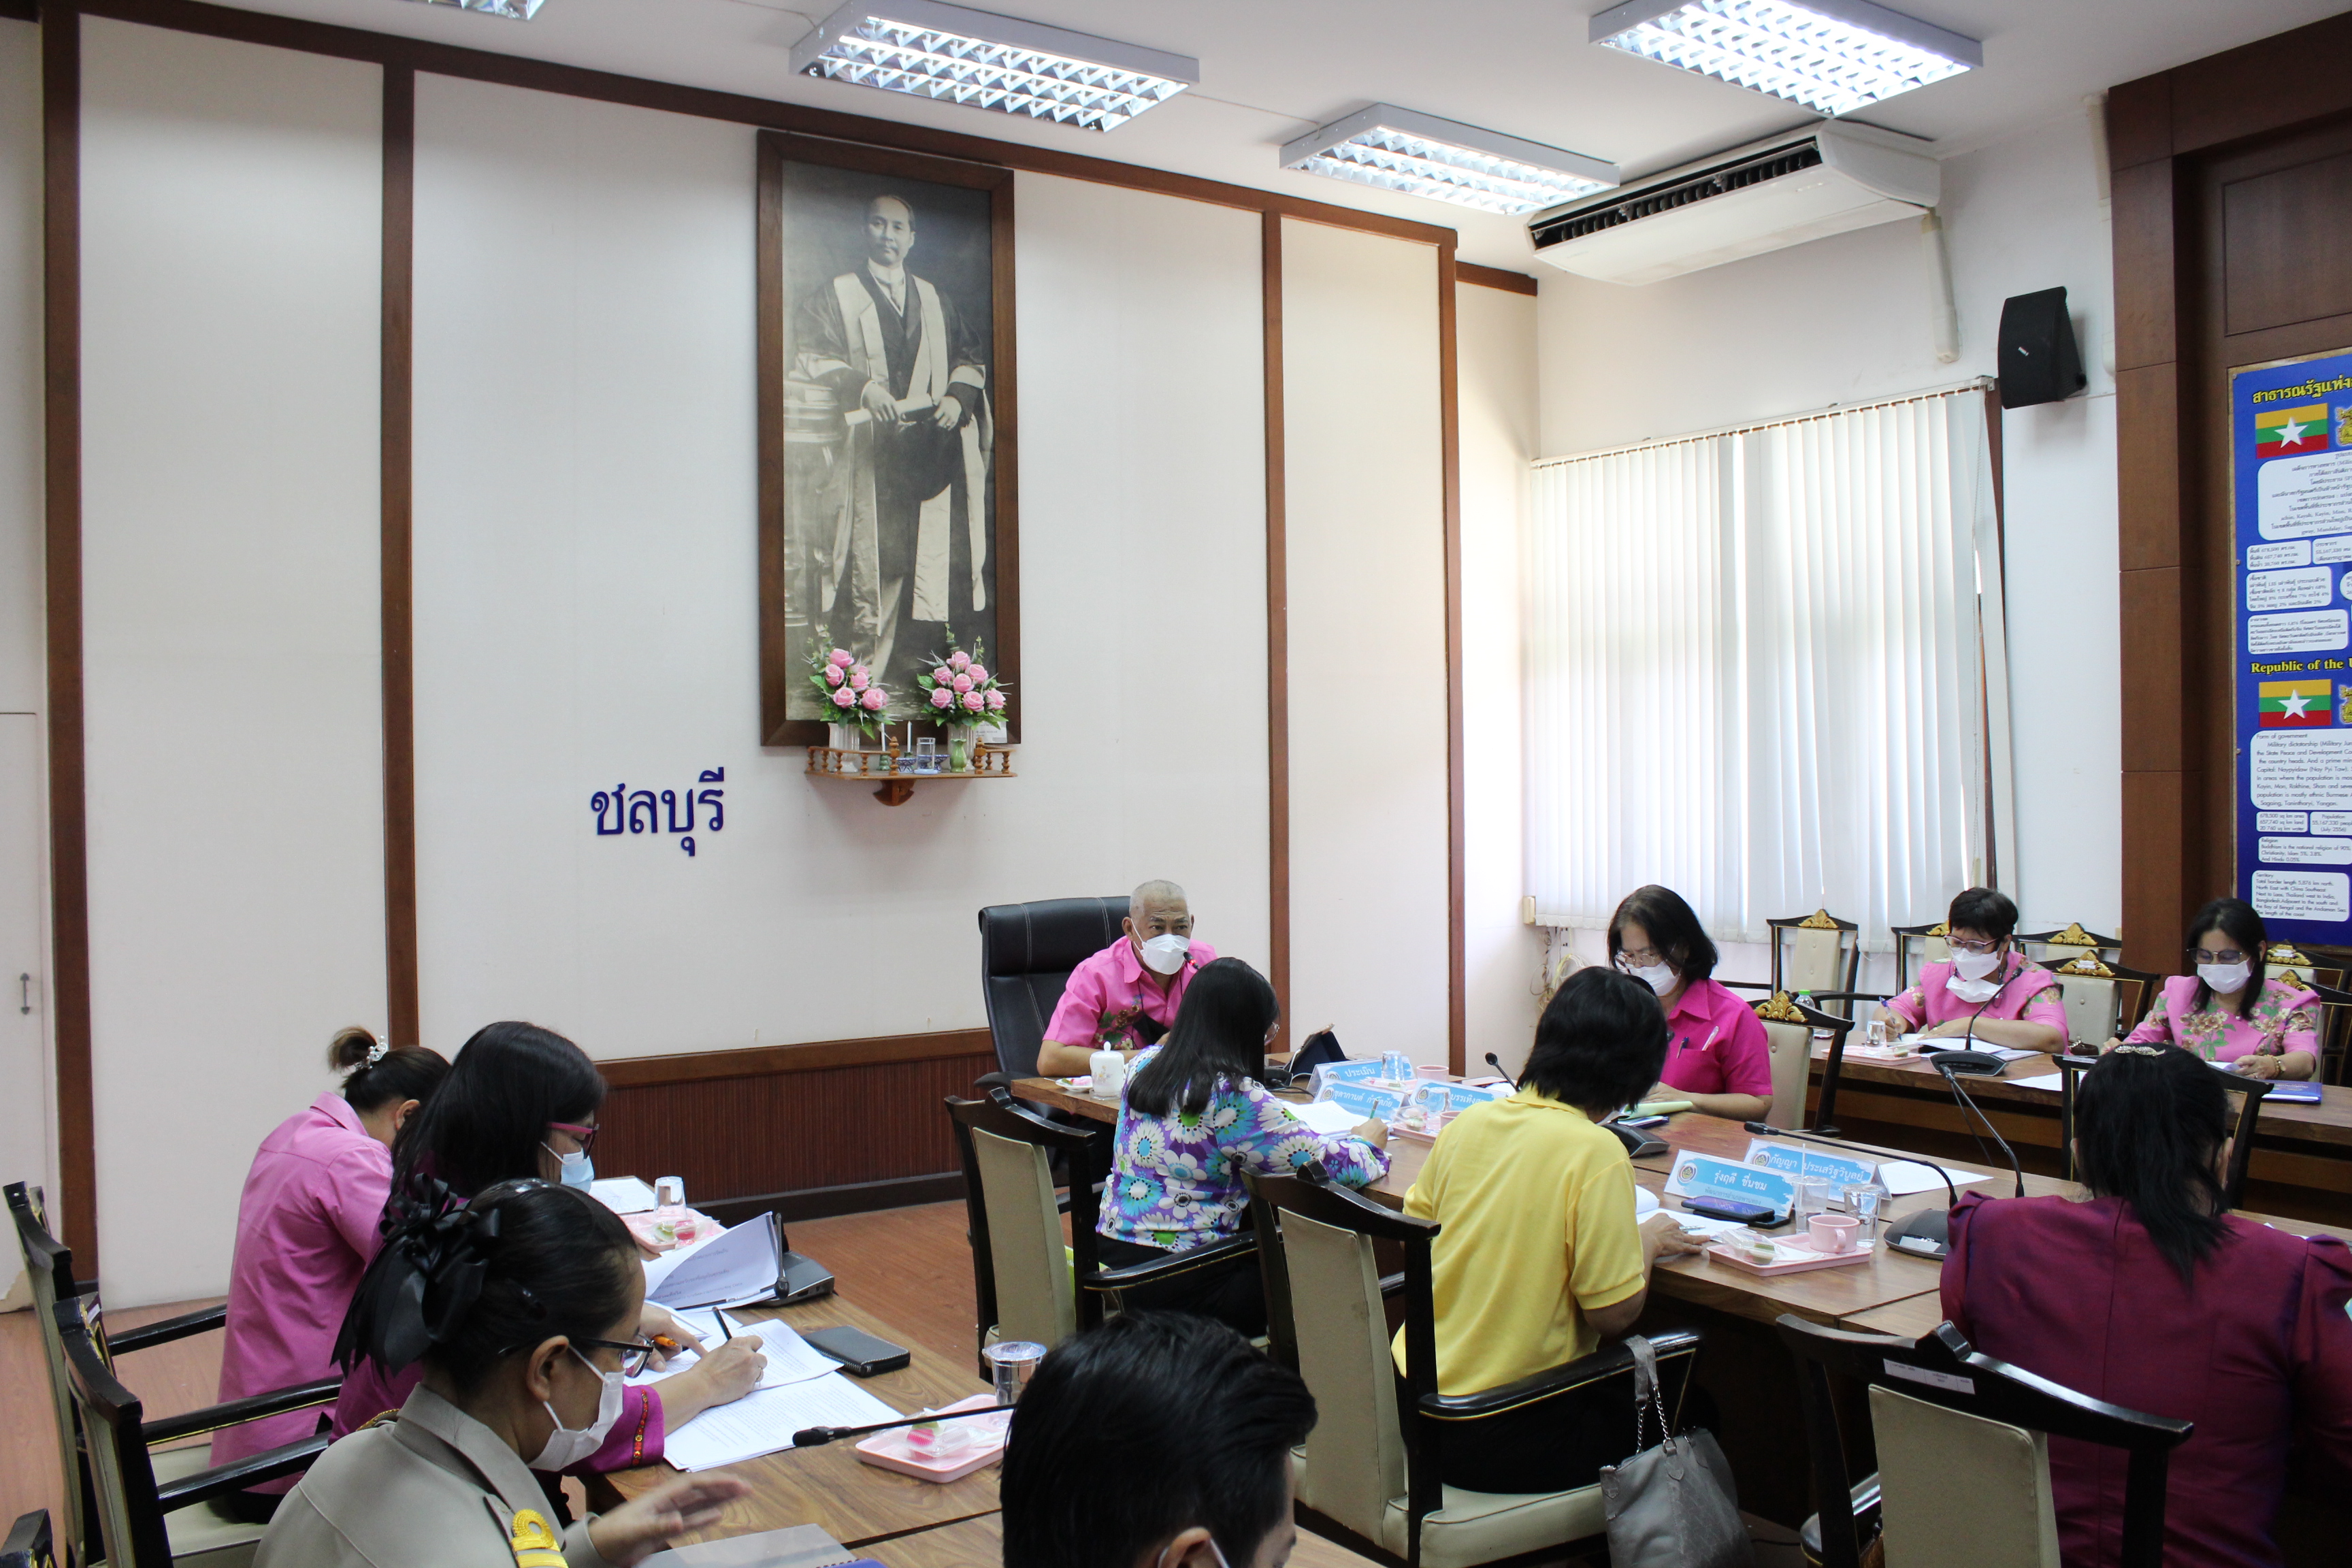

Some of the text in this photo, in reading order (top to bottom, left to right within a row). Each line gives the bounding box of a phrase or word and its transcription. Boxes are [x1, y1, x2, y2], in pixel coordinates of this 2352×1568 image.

[2253, 374, 2352, 404] สาธารณรัฐแห่ง
[2251, 661, 2304, 675] Republic
[2307, 659, 2321, 670] of
[2324, 658, 2344, 670] the
[591, 766, 724, 856] ชลบุรี
[1345, 1066, 1375, 1077] ประเมิน
[1367, 1094, 1393, 1107] กำัดภัย
[1770, 1154, 1865, 1181] กัญญา ประเสริฐวิบูลย์
[1714, 1170, 1767, 1190] รุ่งฤดี ชื่นชม
